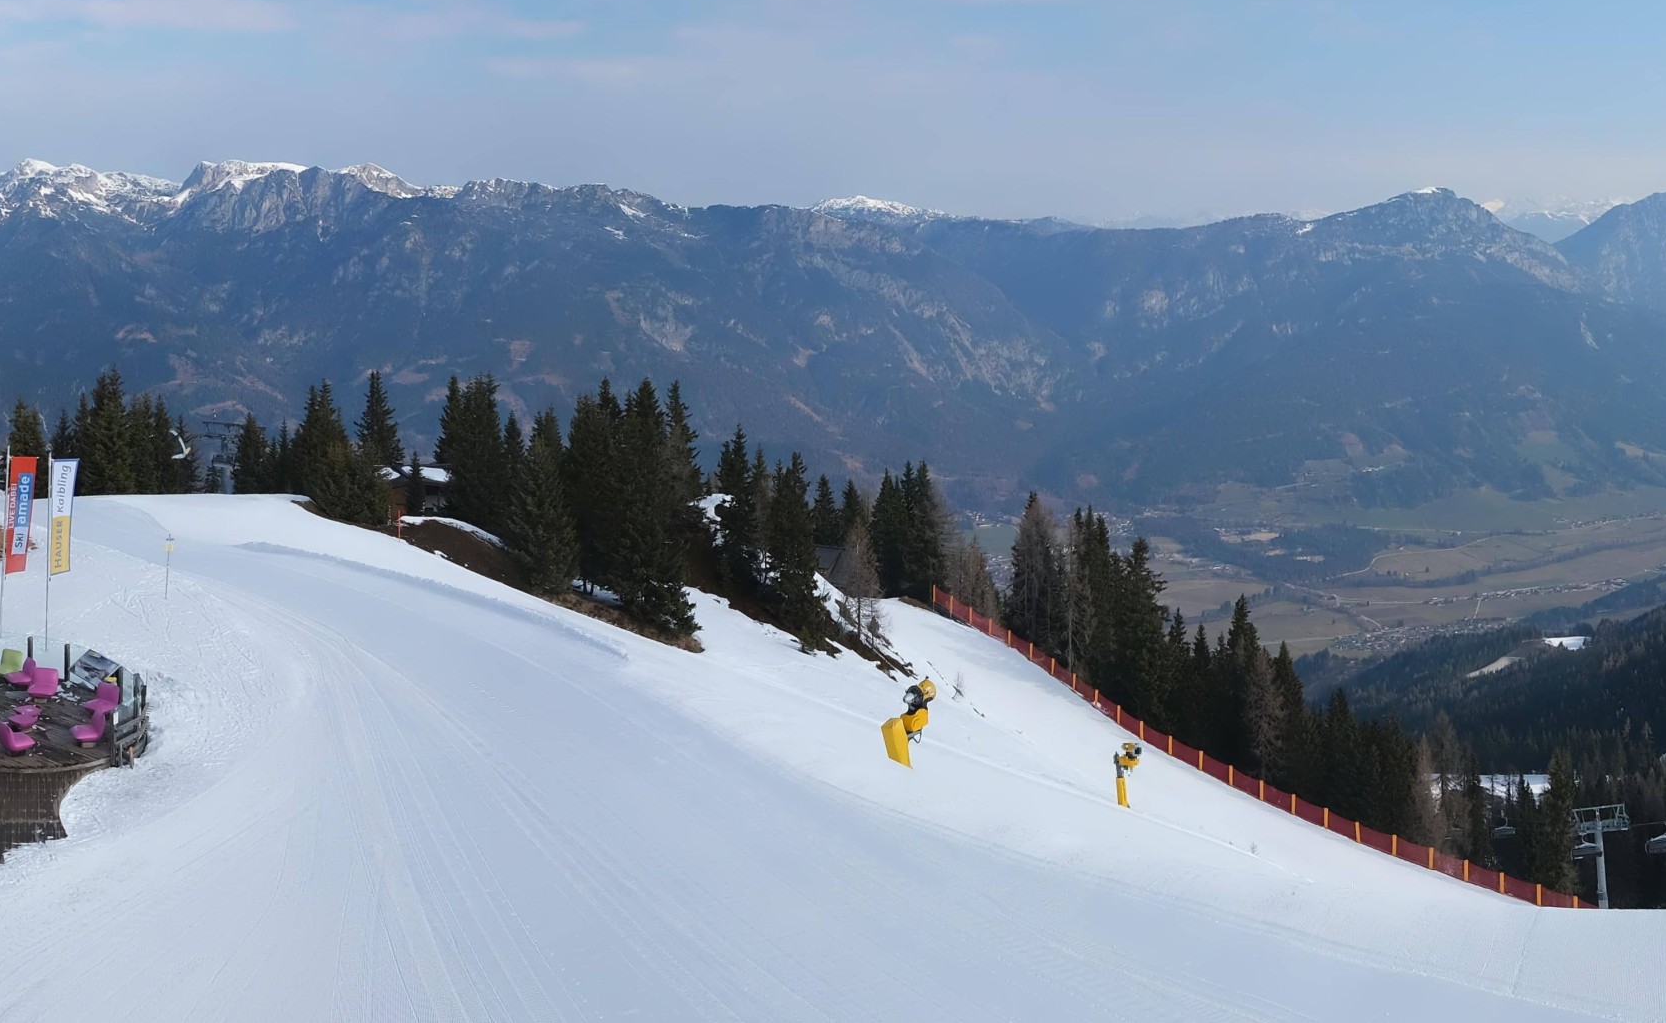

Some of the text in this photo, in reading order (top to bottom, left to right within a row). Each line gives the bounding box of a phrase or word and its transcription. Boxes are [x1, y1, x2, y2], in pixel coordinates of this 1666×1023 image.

[15, 533, 25, 548] Ski
[54, 465, 71, 568] HAUSER Kaibling
